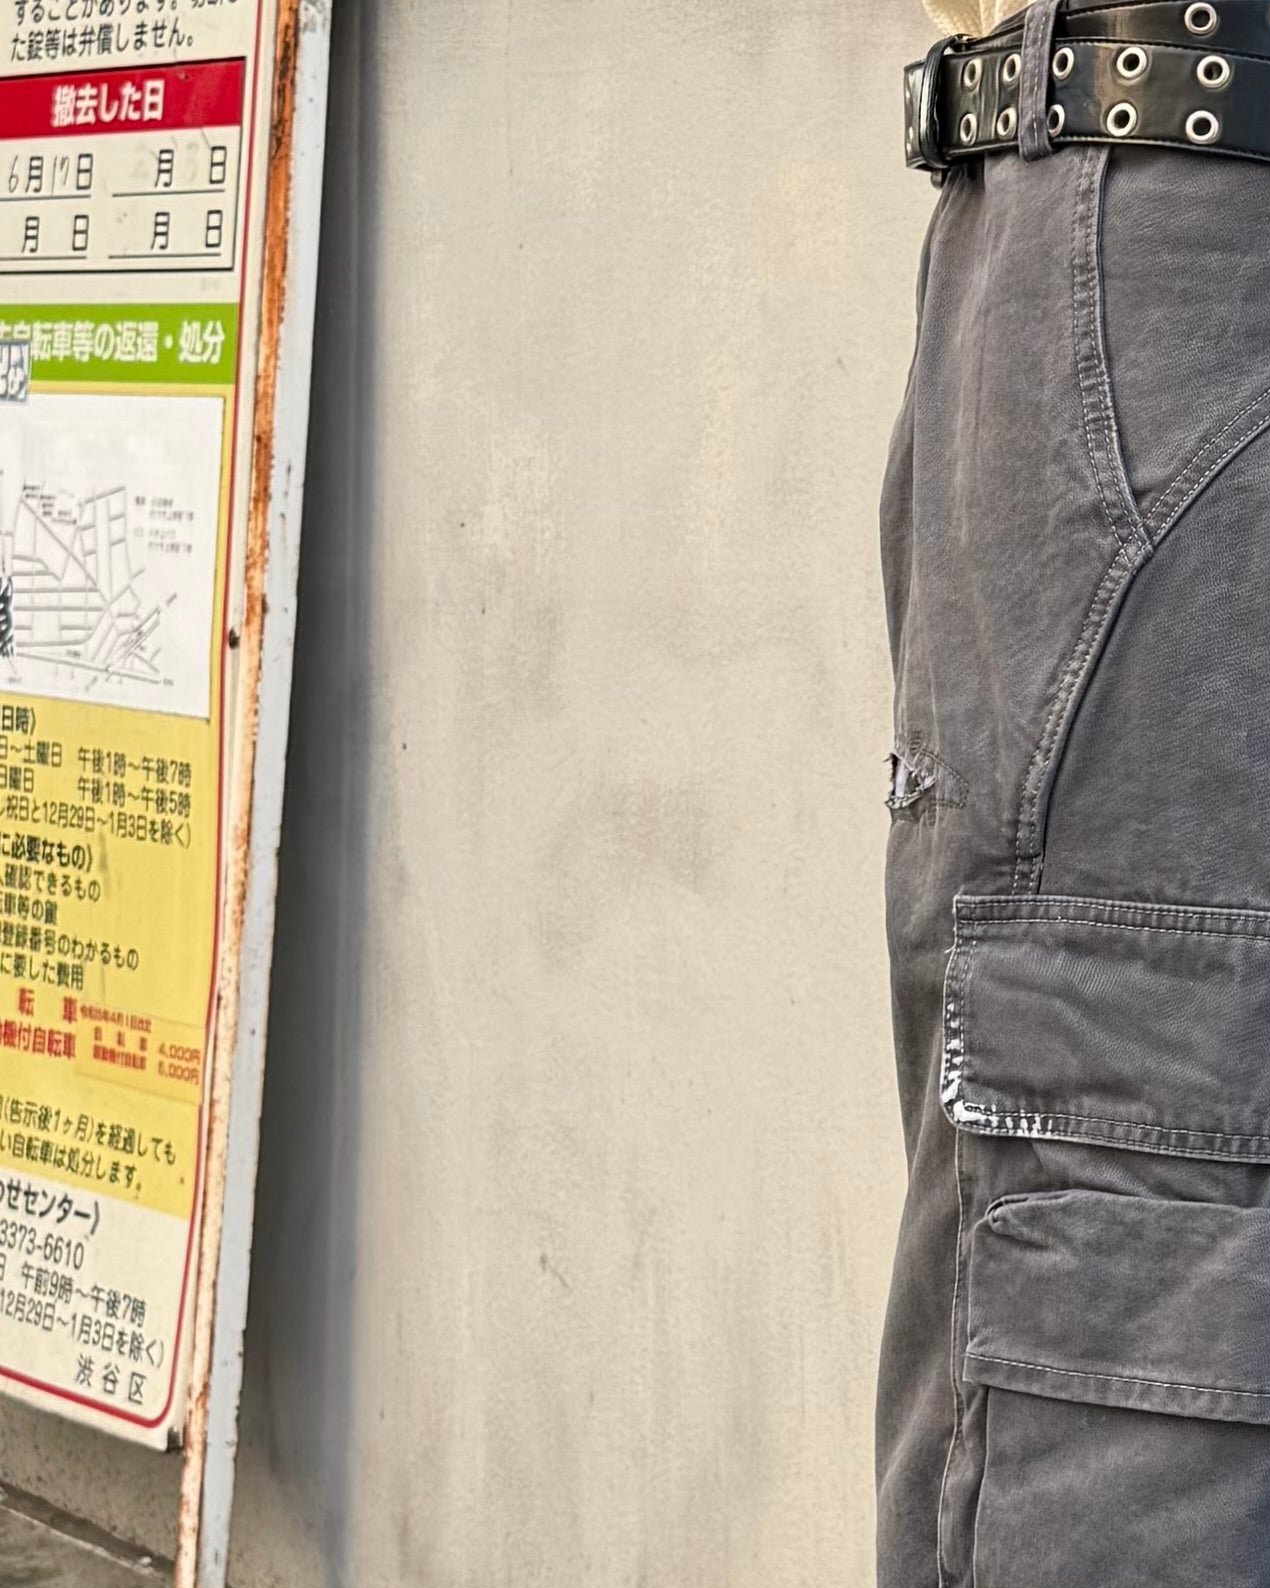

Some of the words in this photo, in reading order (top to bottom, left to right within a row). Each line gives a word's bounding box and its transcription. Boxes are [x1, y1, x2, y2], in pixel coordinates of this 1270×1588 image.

[52, 80, 165, 127] 撤去した日
[155, 149, 174, 188] 月
[209, 146, 227, 184] 日
[21, 215, 40, 253] 月
[72, 214, 89, 251] 日
[151, 211, 170, 250] 月
[205, 210, 223, 248] 日
[0, 796, 192, 849] 祝日と12月29日～1月3日を除く)
[0, 863, 101, 902] 確認できるもの
[0, 891, 57, 926] 車等の鍵
[0, 921, 139, 971] 登録番号のわかるもの
[0, 1020, 76, 1059] 機付自転車
